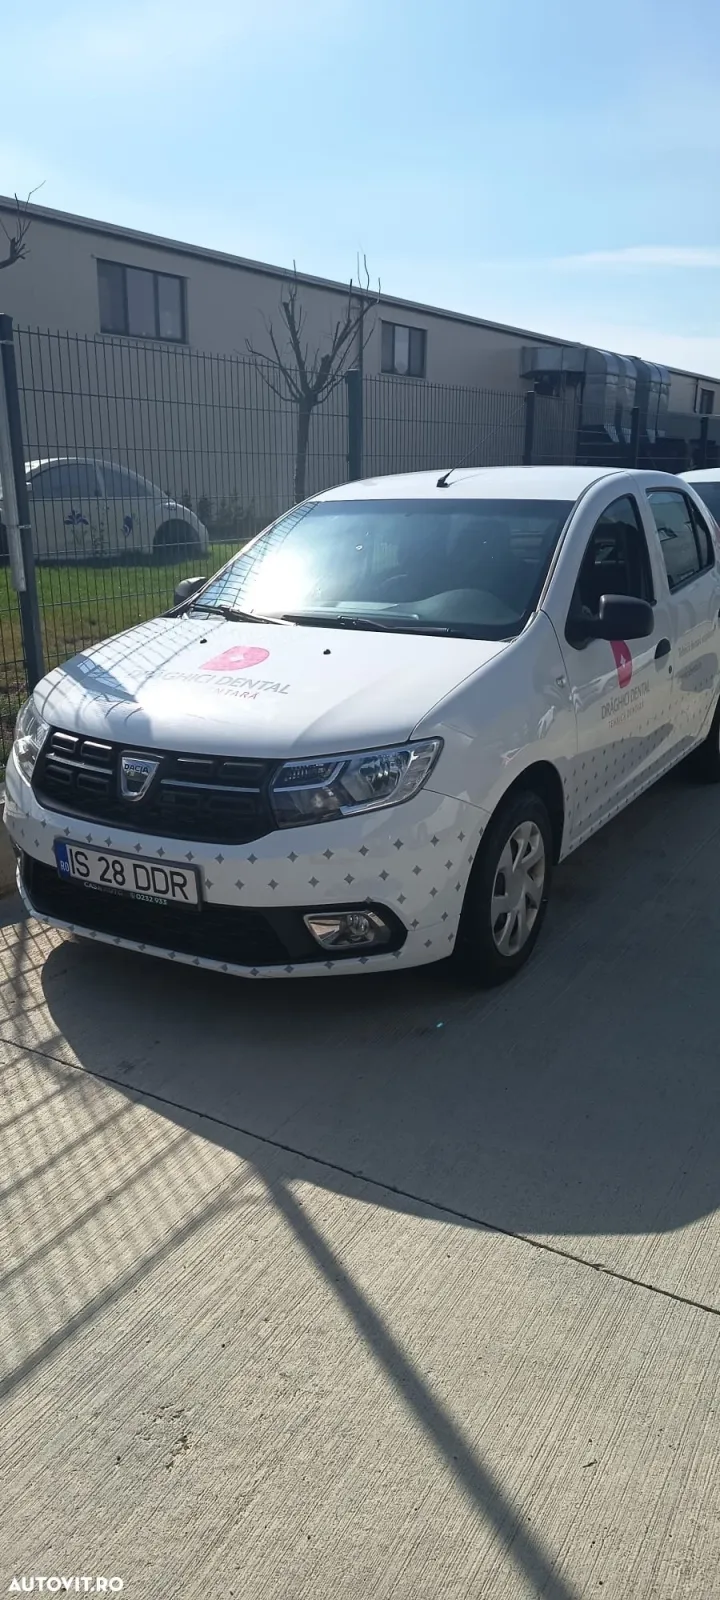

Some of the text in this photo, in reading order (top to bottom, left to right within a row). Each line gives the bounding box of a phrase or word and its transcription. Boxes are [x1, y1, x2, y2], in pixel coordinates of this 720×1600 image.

[215, 676, 291, 695] DENTAL
[125, 763, 149, 773] DACIA
[60, 860, 70, 872] RO
[69, 848, 190, 900] IS 28 DDR
